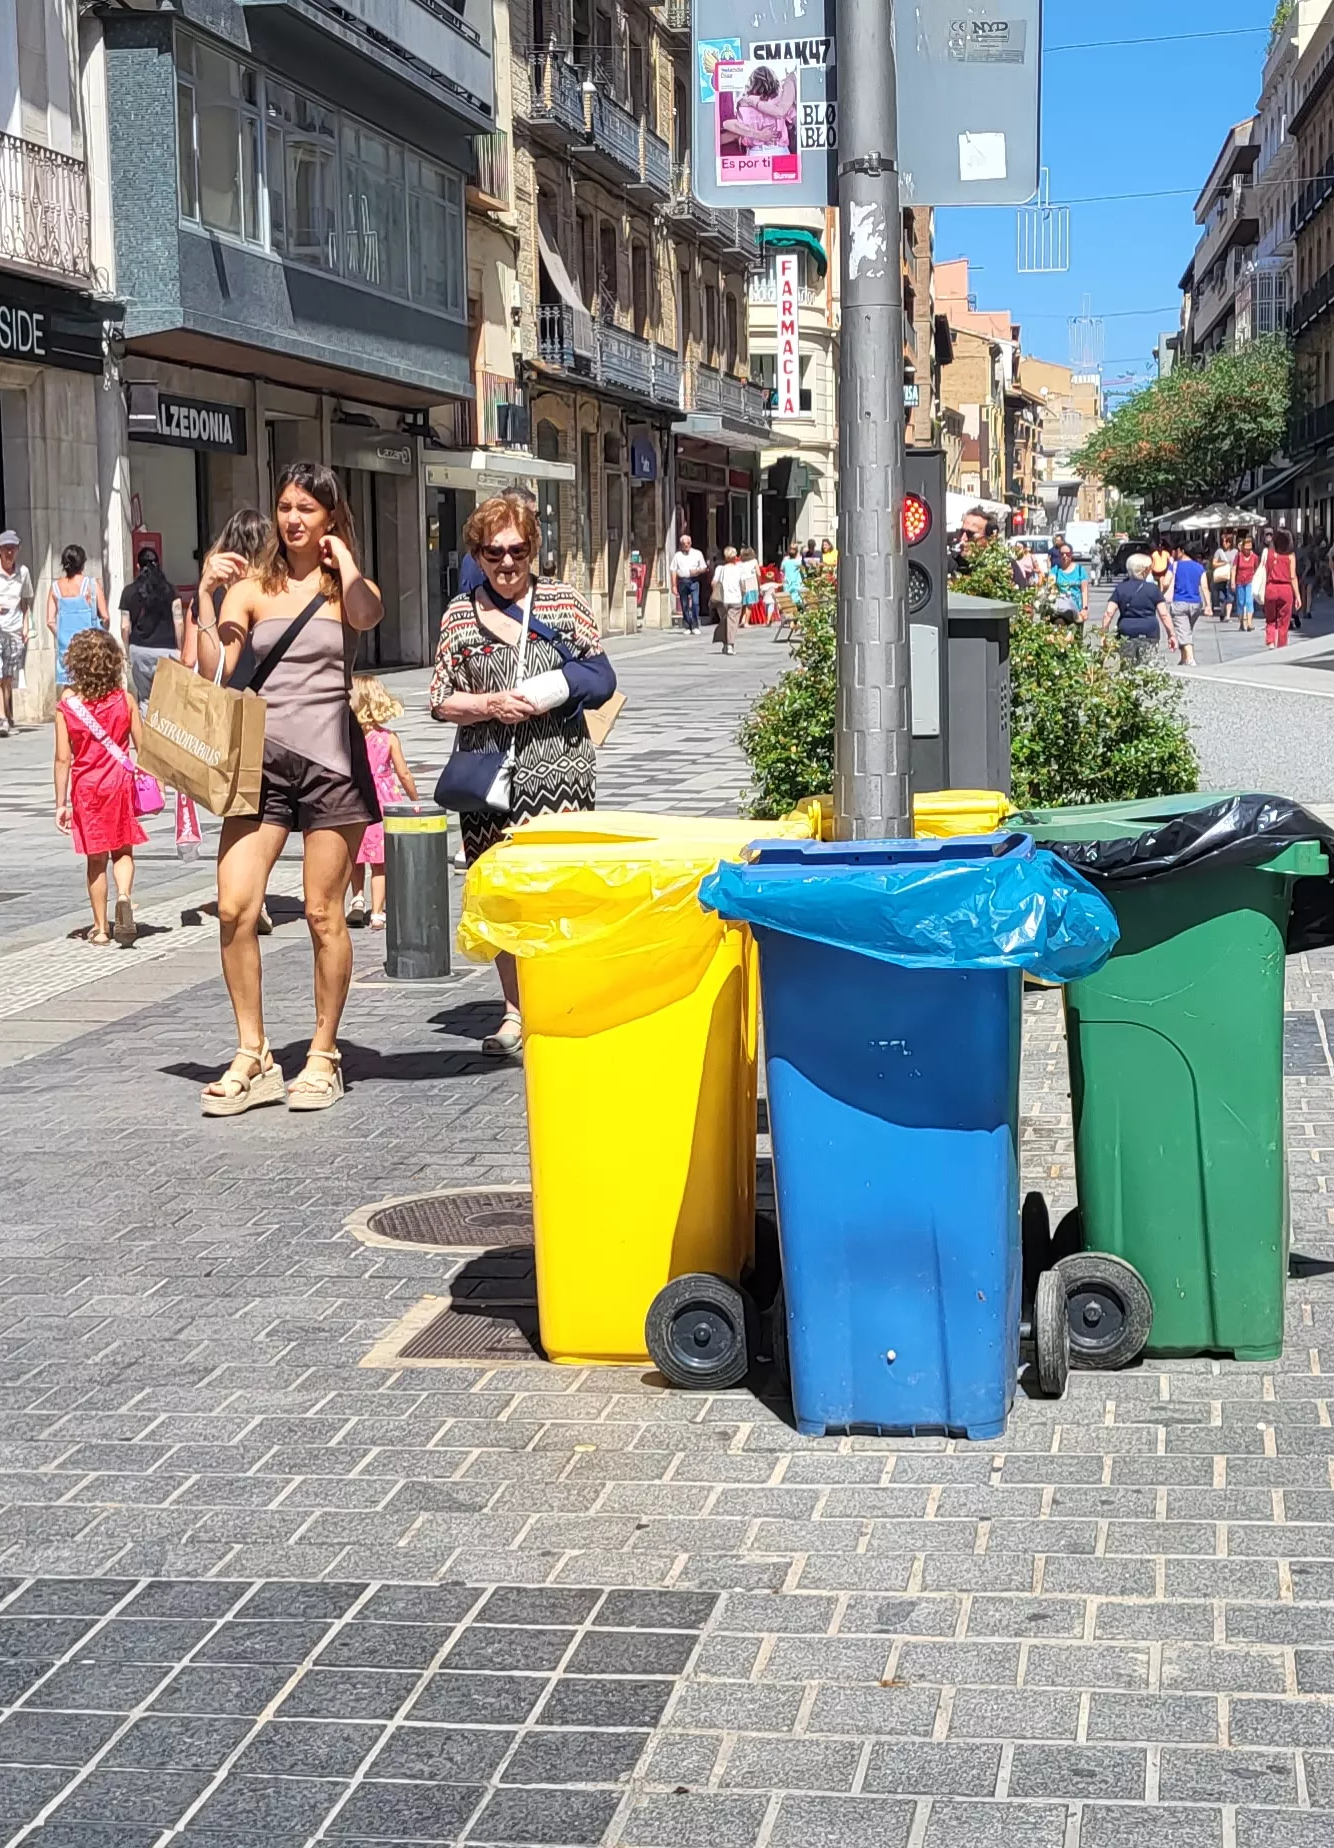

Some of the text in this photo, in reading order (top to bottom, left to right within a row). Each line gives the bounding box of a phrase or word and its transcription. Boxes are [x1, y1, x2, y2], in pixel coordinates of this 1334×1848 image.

[972, 22, 1009, 34] NYD
[722, 157, 771, 171] Es por ti
[780, 260, 794, 414] FARMACIA
[157, 717, 223, 767] STRADIVARIUS
